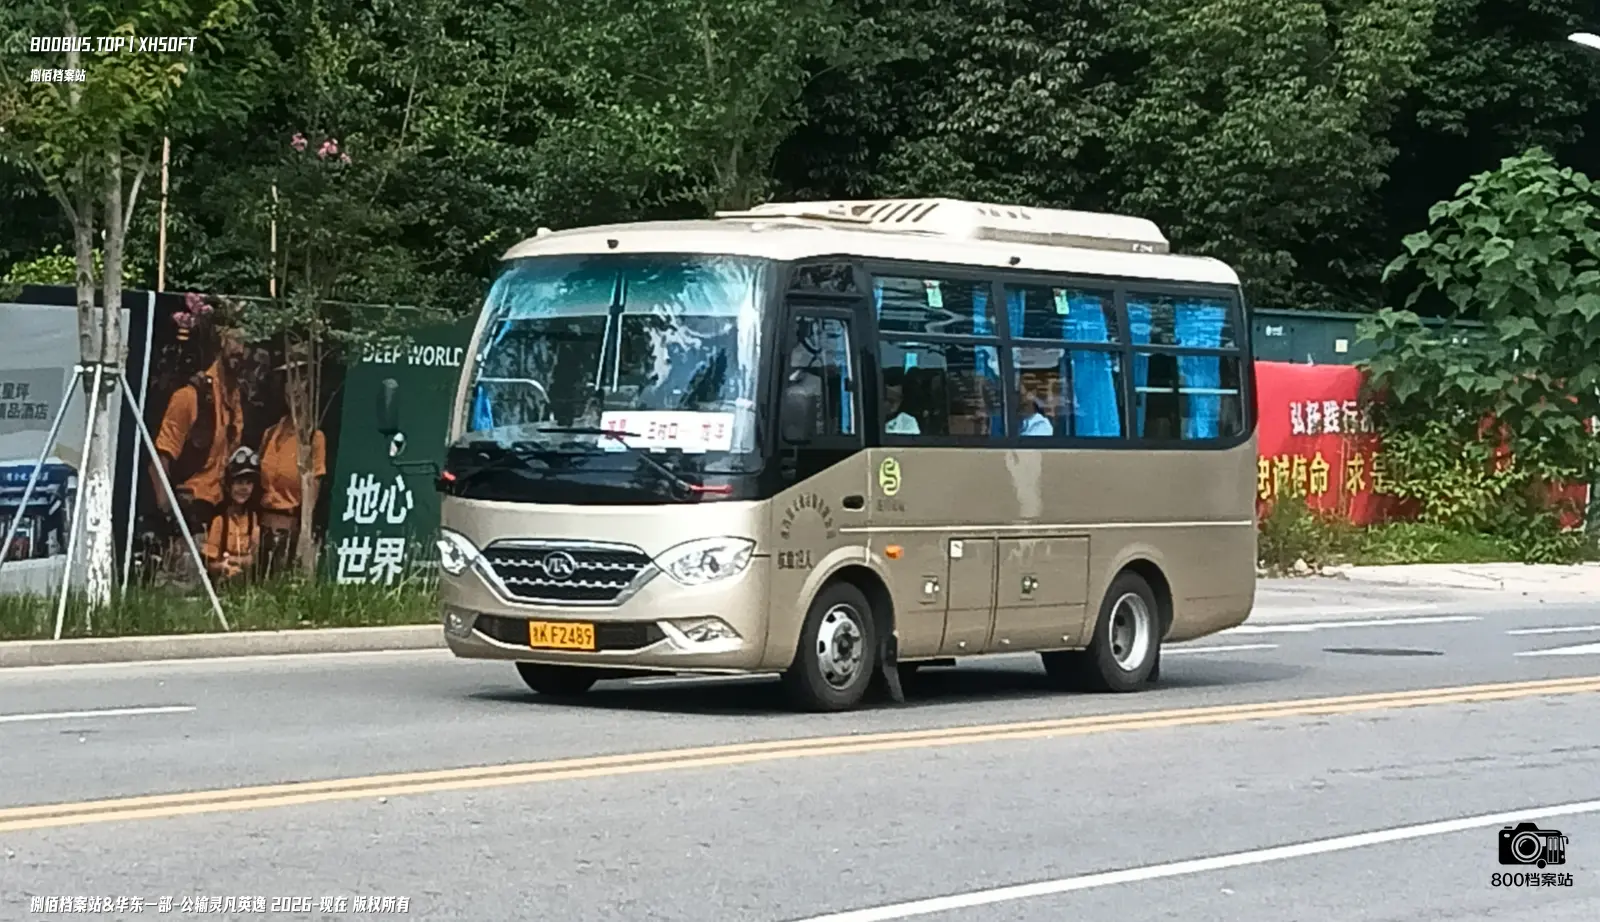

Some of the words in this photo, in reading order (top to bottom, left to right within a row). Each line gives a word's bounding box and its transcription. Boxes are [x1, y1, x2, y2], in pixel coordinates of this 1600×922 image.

[362, 342, 402, 364] DEEP
[342, 473, 414, 524] 地心
[336, 535, 405, 586] 世界
